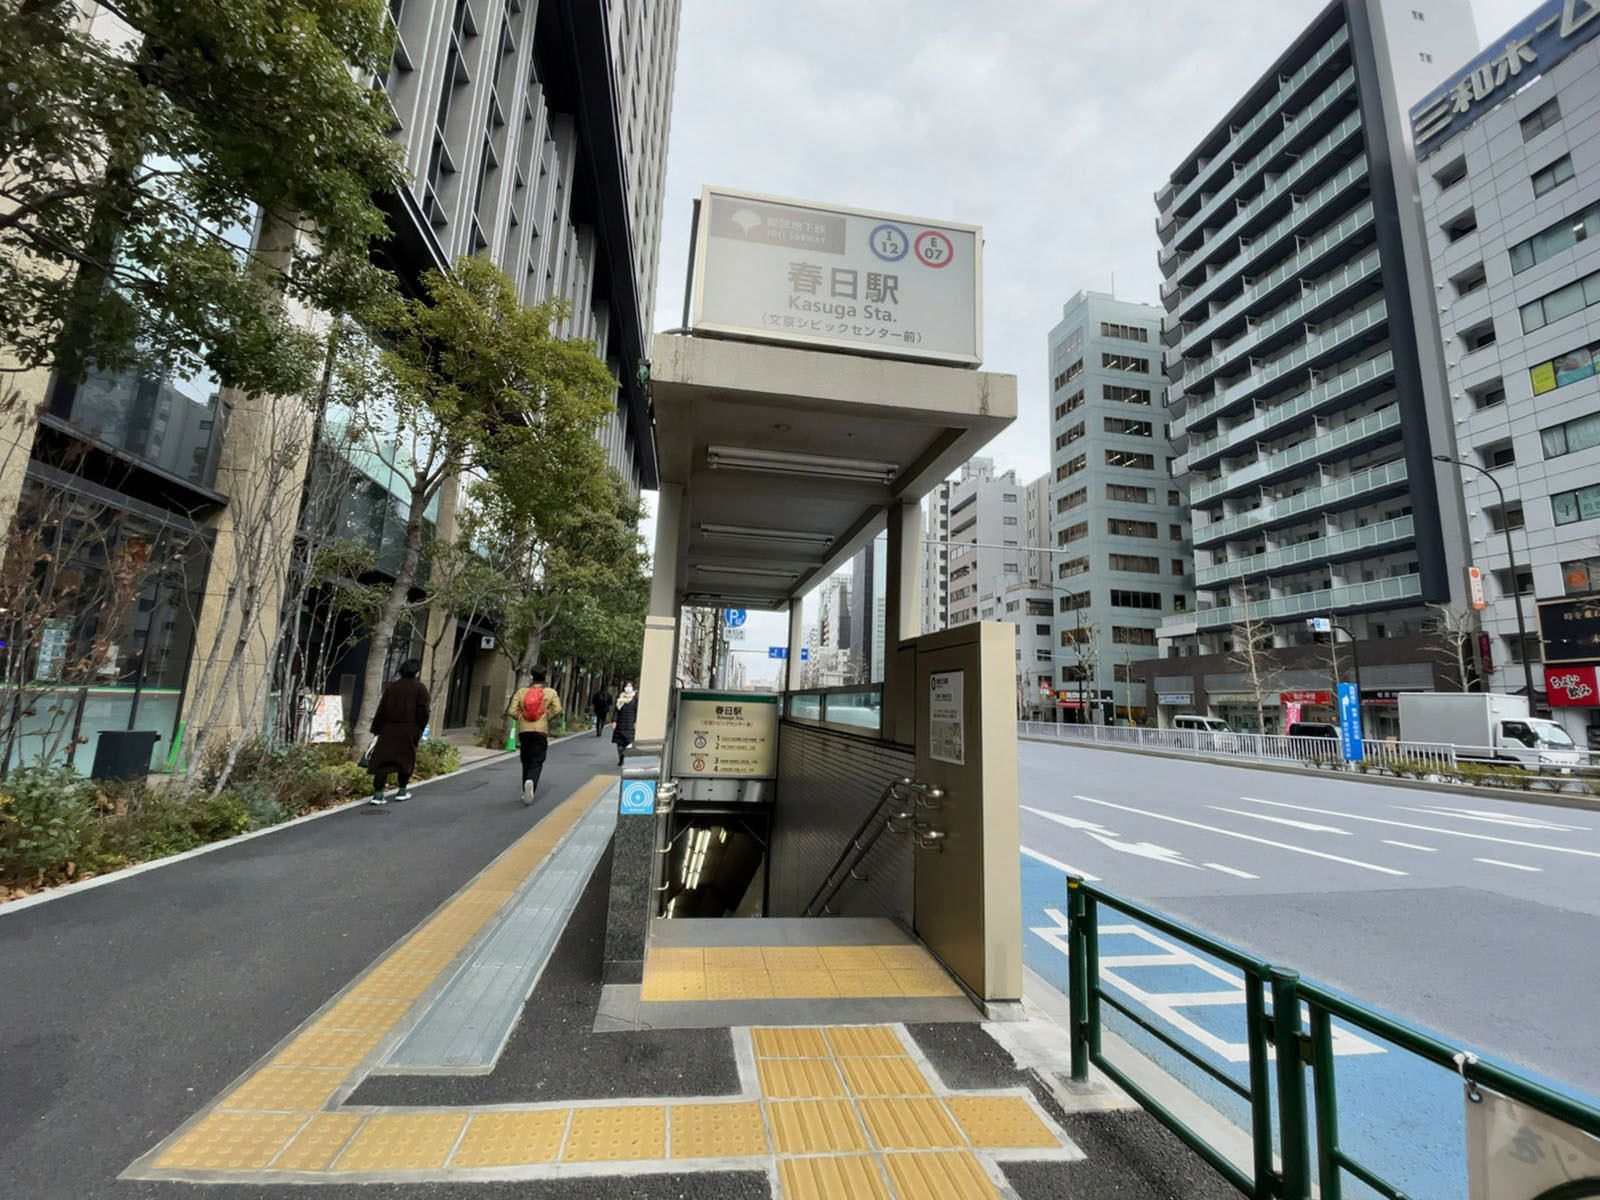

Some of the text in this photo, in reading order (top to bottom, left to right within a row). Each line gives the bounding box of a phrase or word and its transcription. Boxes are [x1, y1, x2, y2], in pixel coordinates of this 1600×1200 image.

[881, 242, 899, 254] 12
[930, 237, 938, 248] E
[924, 248, 943, 260] 07
[787, 261, 900, 305] 春日駅
[788, 295, 897, 324] Kasuga Sta.
